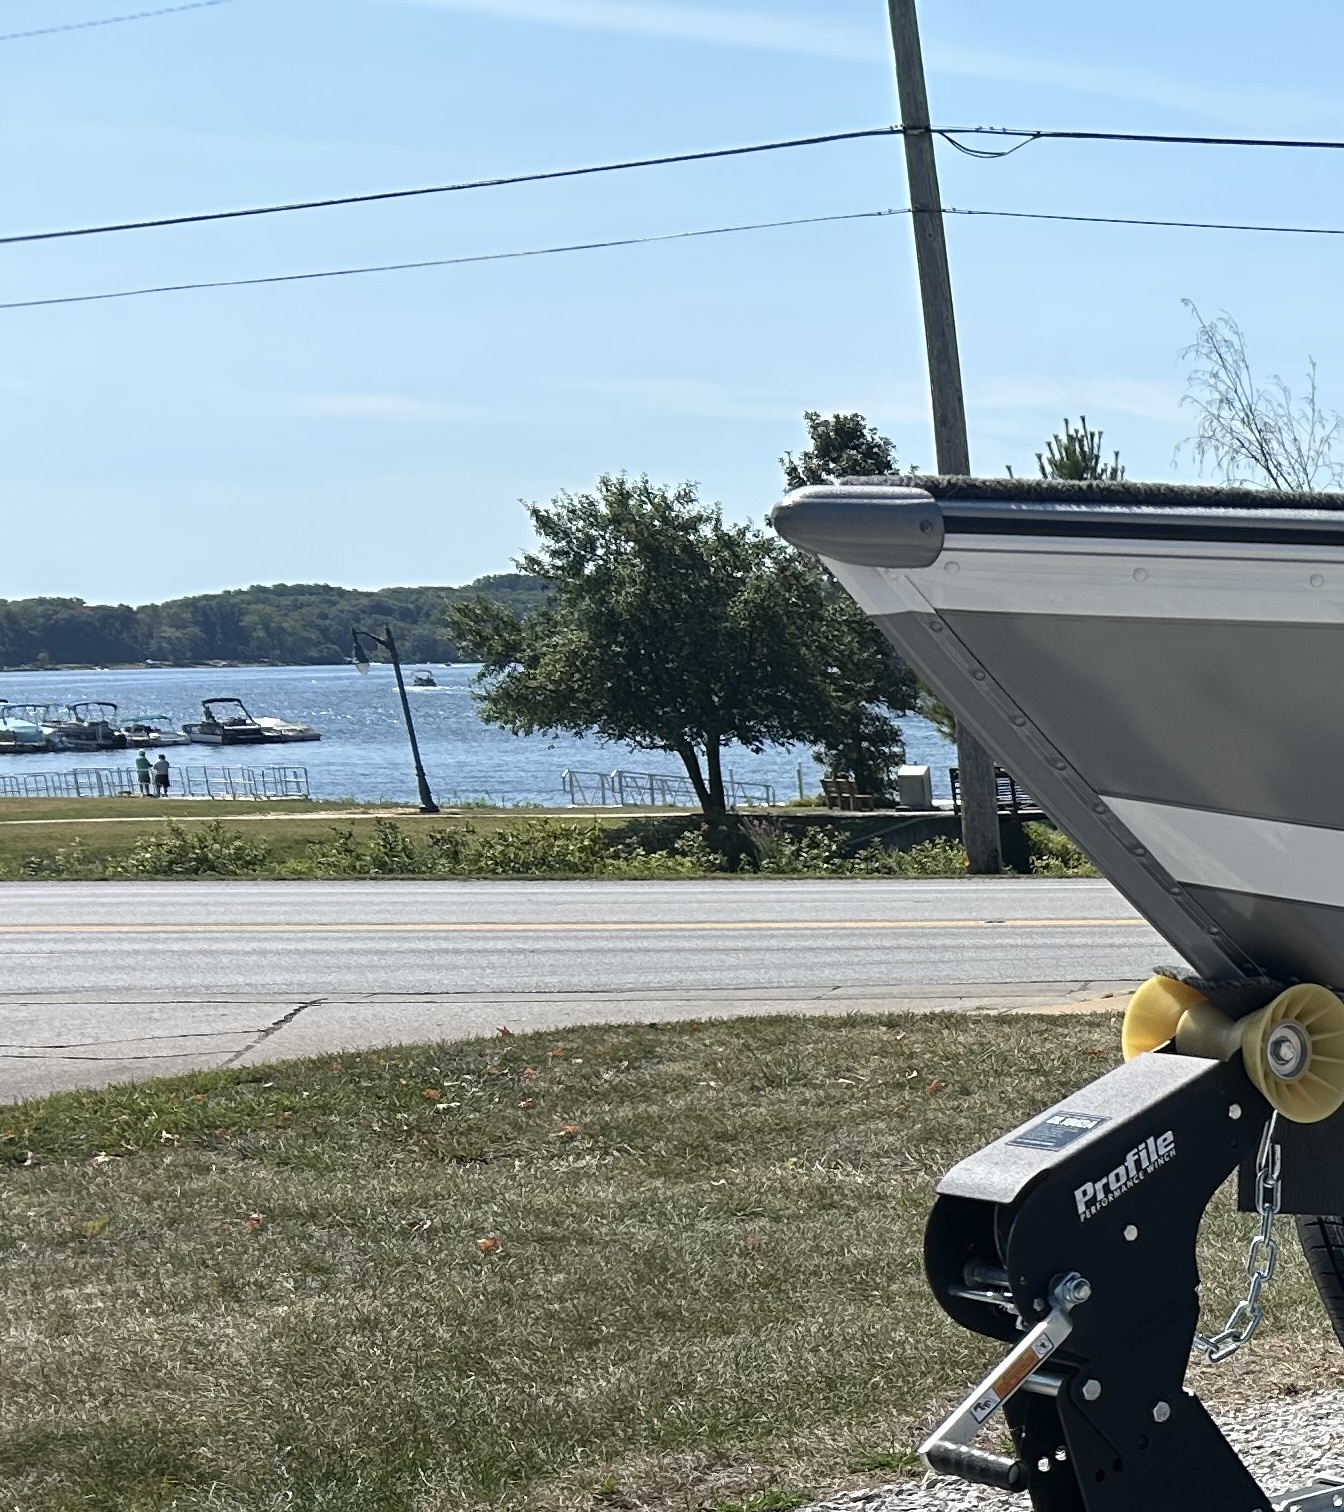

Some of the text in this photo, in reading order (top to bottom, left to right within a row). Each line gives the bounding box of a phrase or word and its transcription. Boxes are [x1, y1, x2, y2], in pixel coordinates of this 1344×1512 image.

[1073, 1130, 1175, 1214] Profile
[1080, 1148, 1176, 1222] PERFORMANCE WINCH
